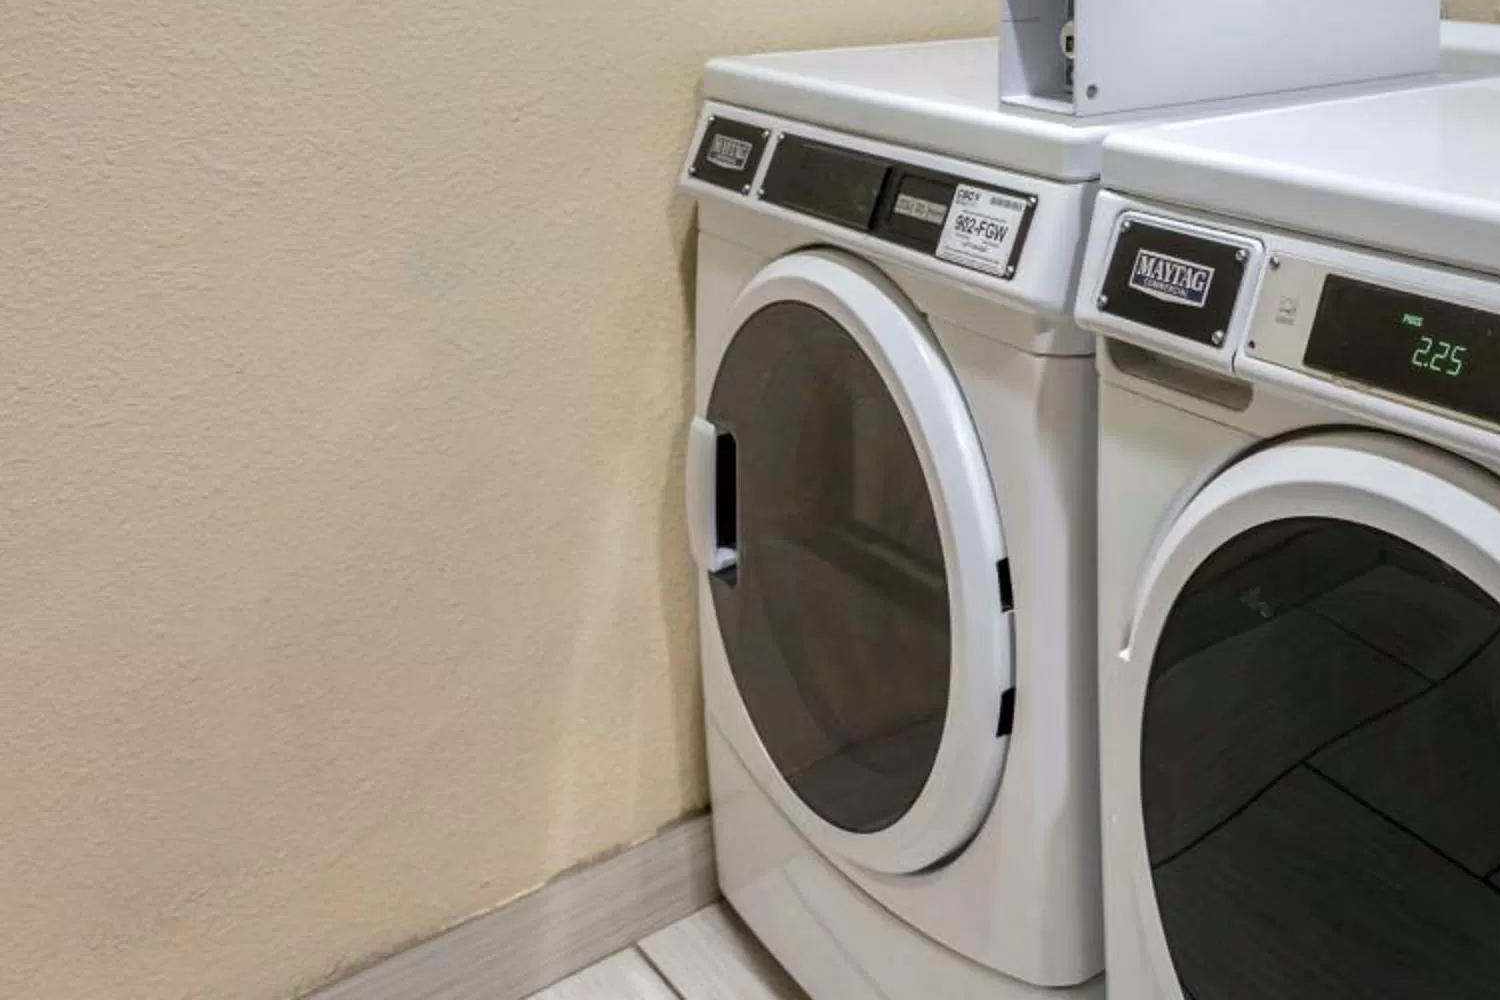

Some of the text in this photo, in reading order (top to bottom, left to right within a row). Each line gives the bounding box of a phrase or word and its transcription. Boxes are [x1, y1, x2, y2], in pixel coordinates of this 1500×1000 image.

[954, 215, 1009, 243] 902-FGW
[1137, 255, 1206, 291] MAYTAG
[1412, 336, 1468, 376] 2.25
